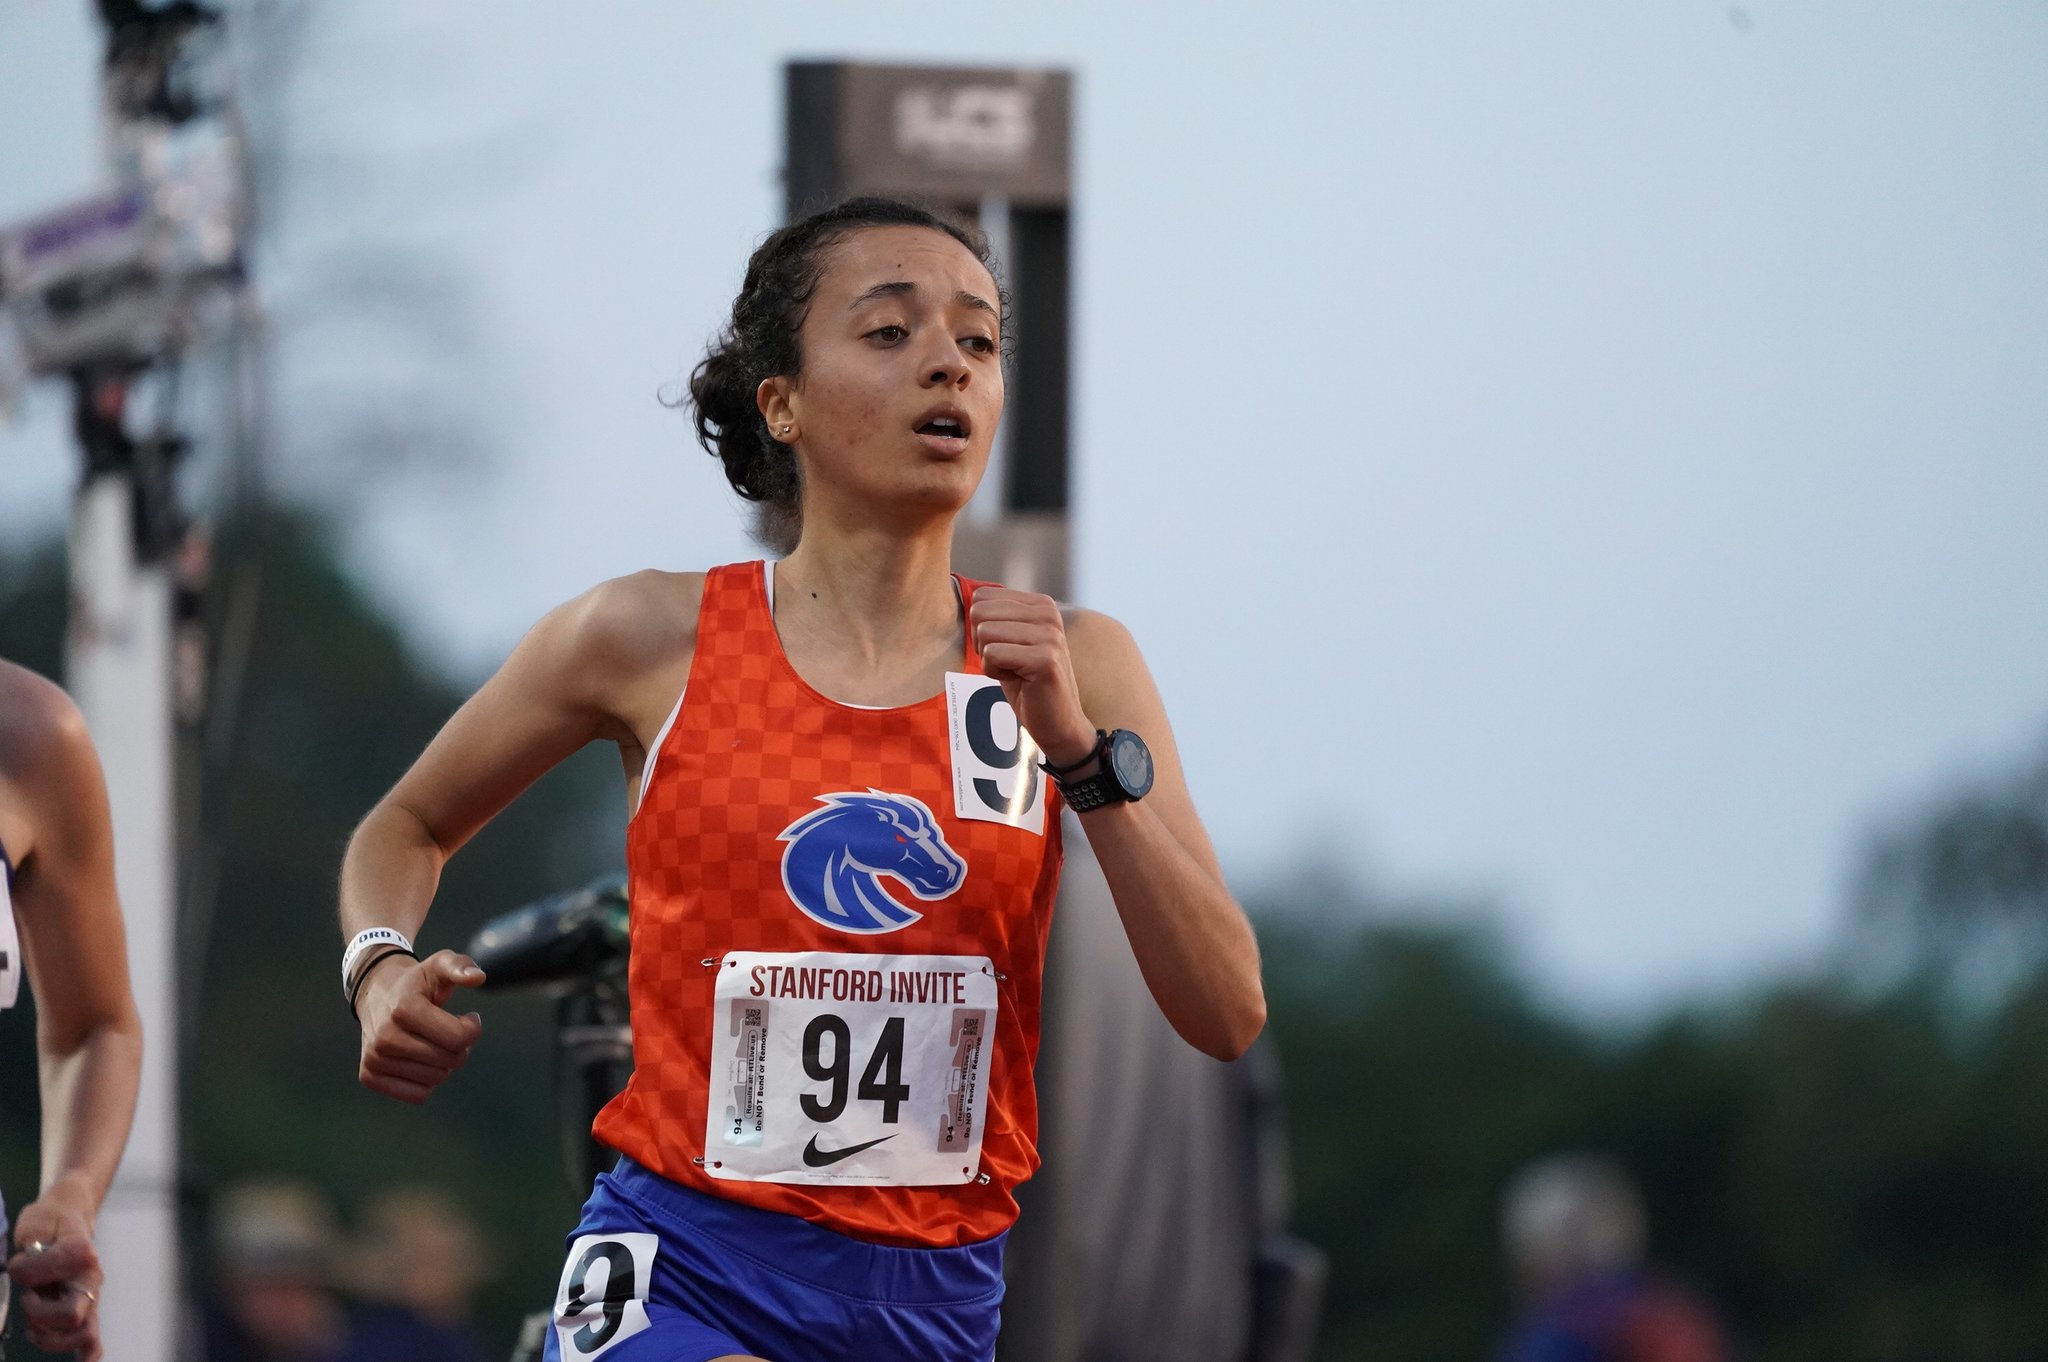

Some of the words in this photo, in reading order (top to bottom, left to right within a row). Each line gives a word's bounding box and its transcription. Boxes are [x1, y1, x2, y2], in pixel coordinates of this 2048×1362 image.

[965, 686, 1039, 816] 9
[750, 965, 883, 1001] STANFORD
[890, 971, 966, 1004] INVITE
[759, 1028, 767, 1062] Remove
[972, 1037, 981, 1069] Remove
[759, 1065, 765, 1073] or
[800, 1013, 910, 1123] 94
[970, 1072, 976, 1081] or
[757, 1075, 765, 1097] Bend
[967, 1083, 975, 1104] Bend
[734, 1118, 743, 1135] 94
[756, 1120, 762, 1131] Do
[946, 1126, 954, 1142] 94
[964, 1127, 970, 1138] Do
[564, 1242, 635, 1354] 9
